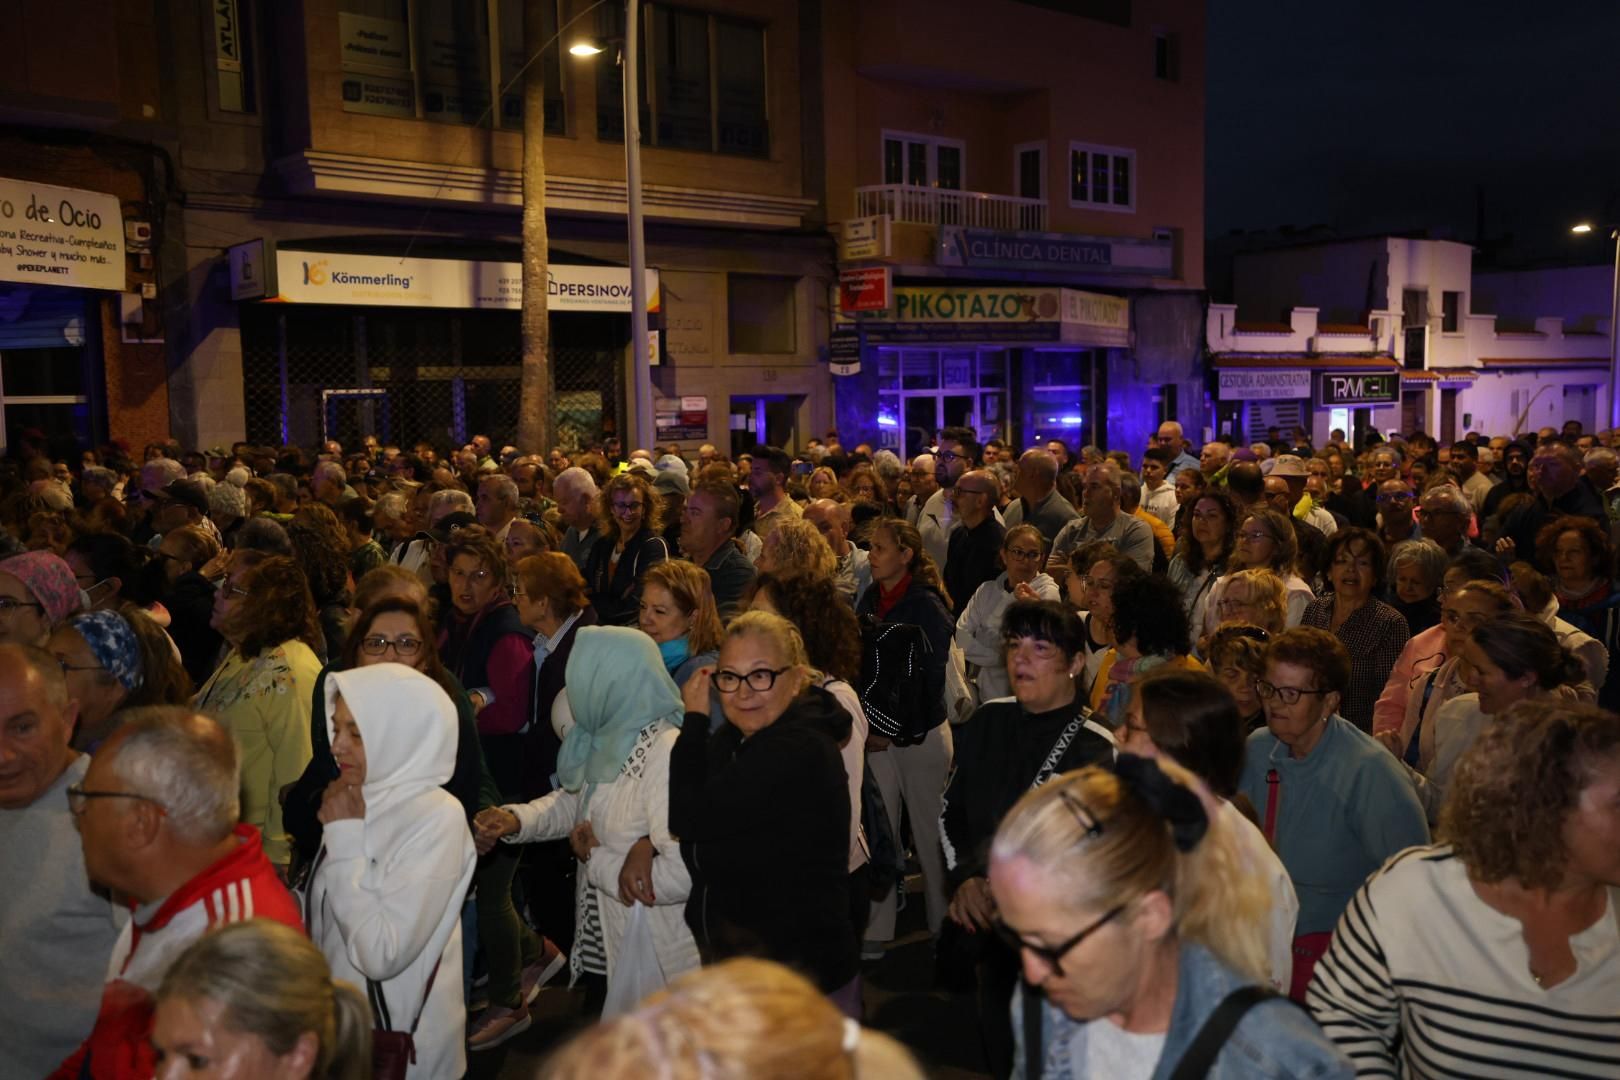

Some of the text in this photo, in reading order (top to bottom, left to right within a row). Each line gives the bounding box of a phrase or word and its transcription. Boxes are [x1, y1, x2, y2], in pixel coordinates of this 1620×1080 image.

[0, 193, 102, 230] o de Ocio
[0, 229, 17, 240] ona
[16, 244, 48, 258] Shower
[51, 252, 57, 262] y
[59, 251, 88, 263] mucho
[971, 236, 1109, 264] CLÍNICA DENTAL
[331, 271, 411, 290] Kömmerling
[896, 293, 1022, 320] PIKOTAZO
